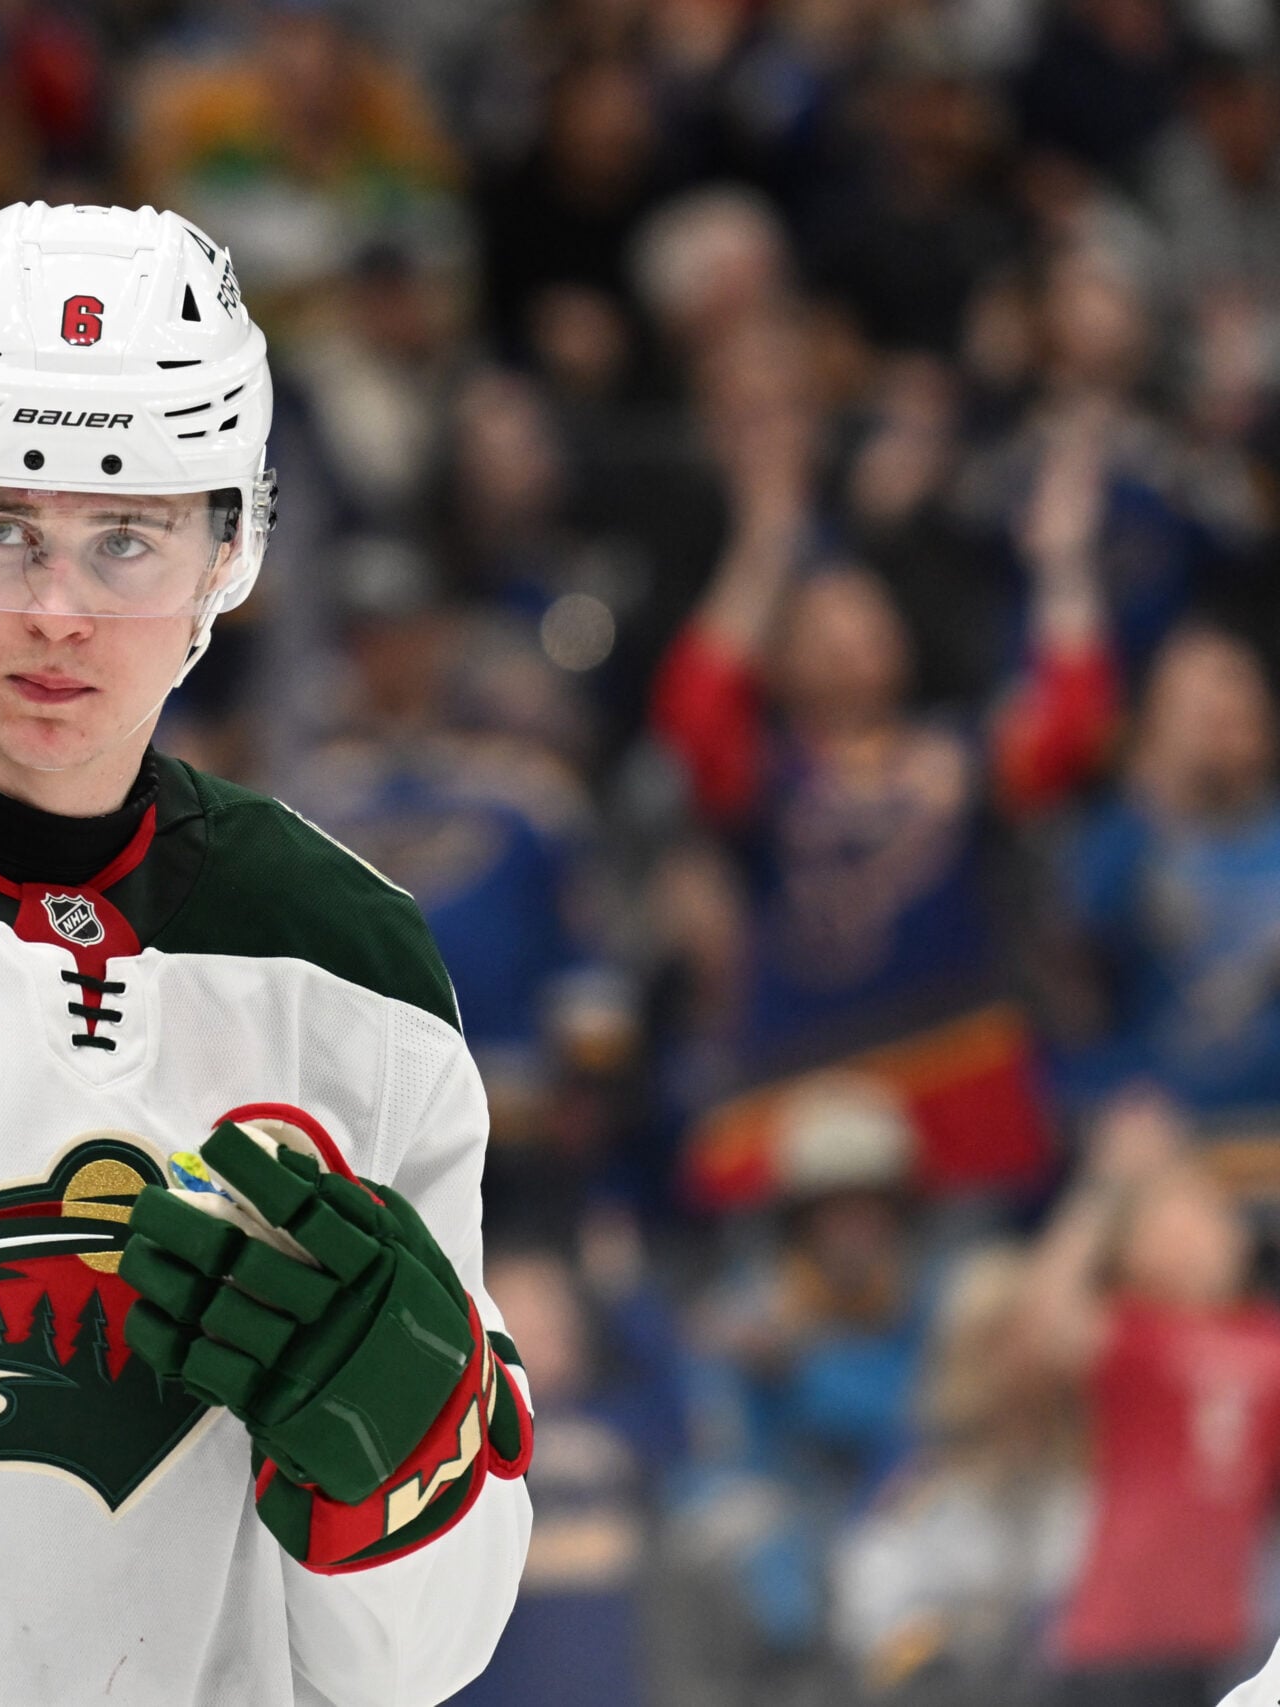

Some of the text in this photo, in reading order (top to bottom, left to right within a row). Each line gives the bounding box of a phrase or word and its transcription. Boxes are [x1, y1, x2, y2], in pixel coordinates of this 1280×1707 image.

[217, 259, 241, 319] FORT
[61, 295, 104, 346] 6
[12, 407, 134, 430] BAUER
[62, 908, 88, 933] NHL
